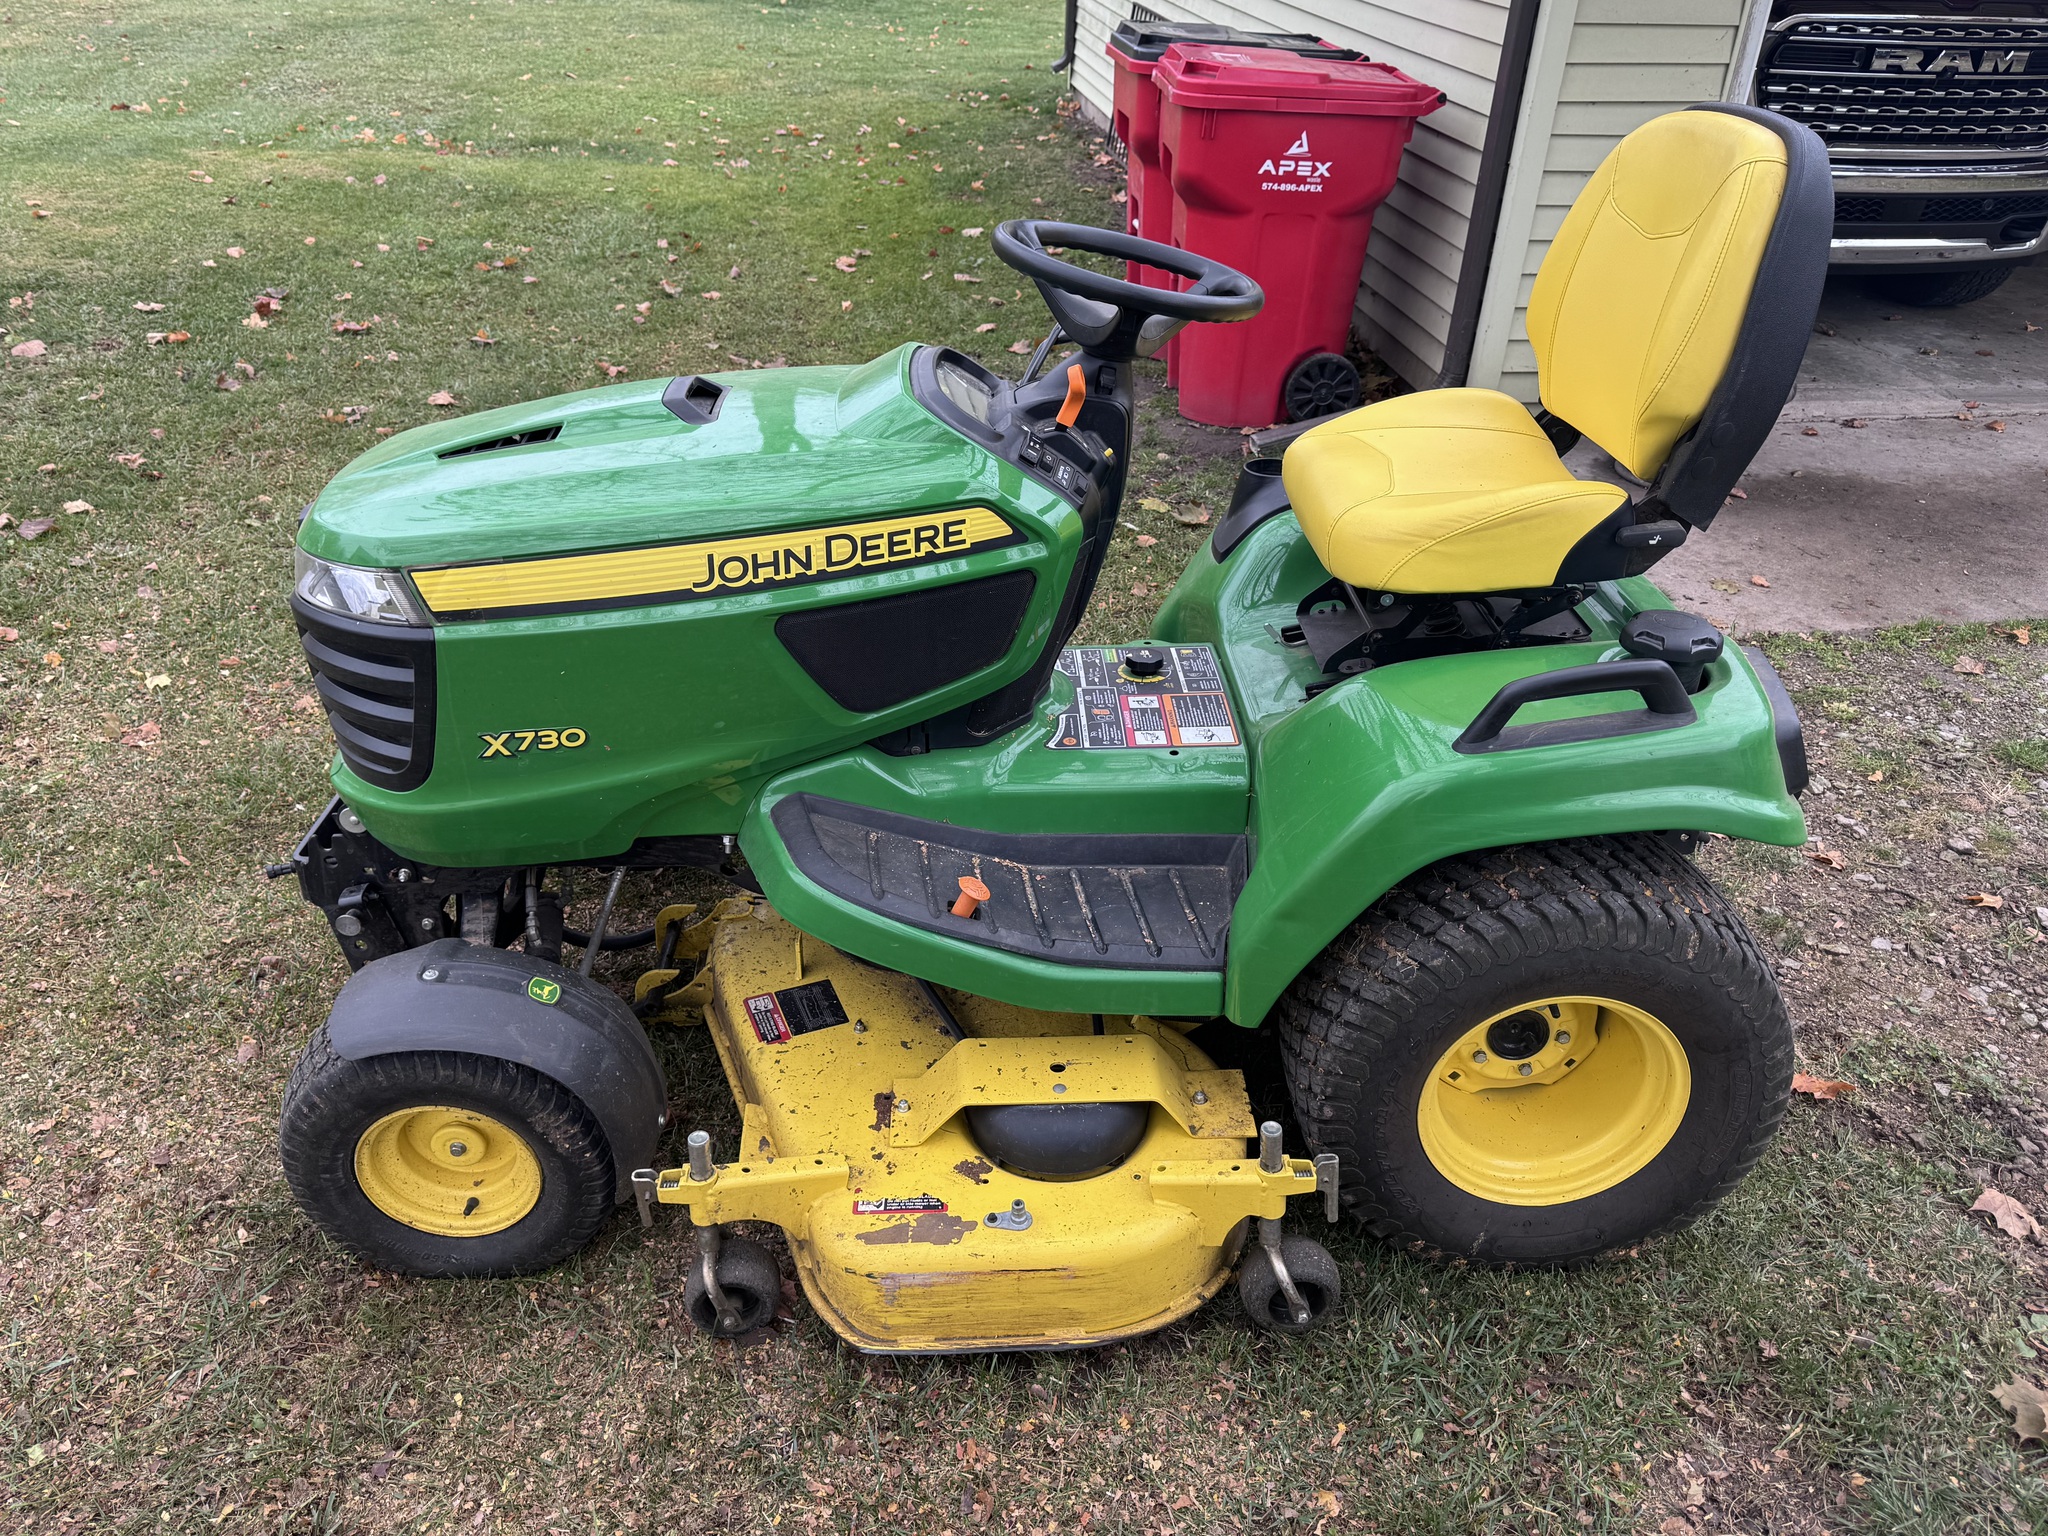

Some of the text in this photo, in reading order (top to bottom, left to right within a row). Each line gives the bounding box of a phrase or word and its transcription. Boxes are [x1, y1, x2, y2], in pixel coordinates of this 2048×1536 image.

[1869, 48, 2032, 73] RAM
[1257, 159, 1333, 177] APEX
[1261, 182, 1323, 192] 574-896-APEX
[691, 517, 968, 591] JOHN DEERE
[478, 726, 588, 759] X730
